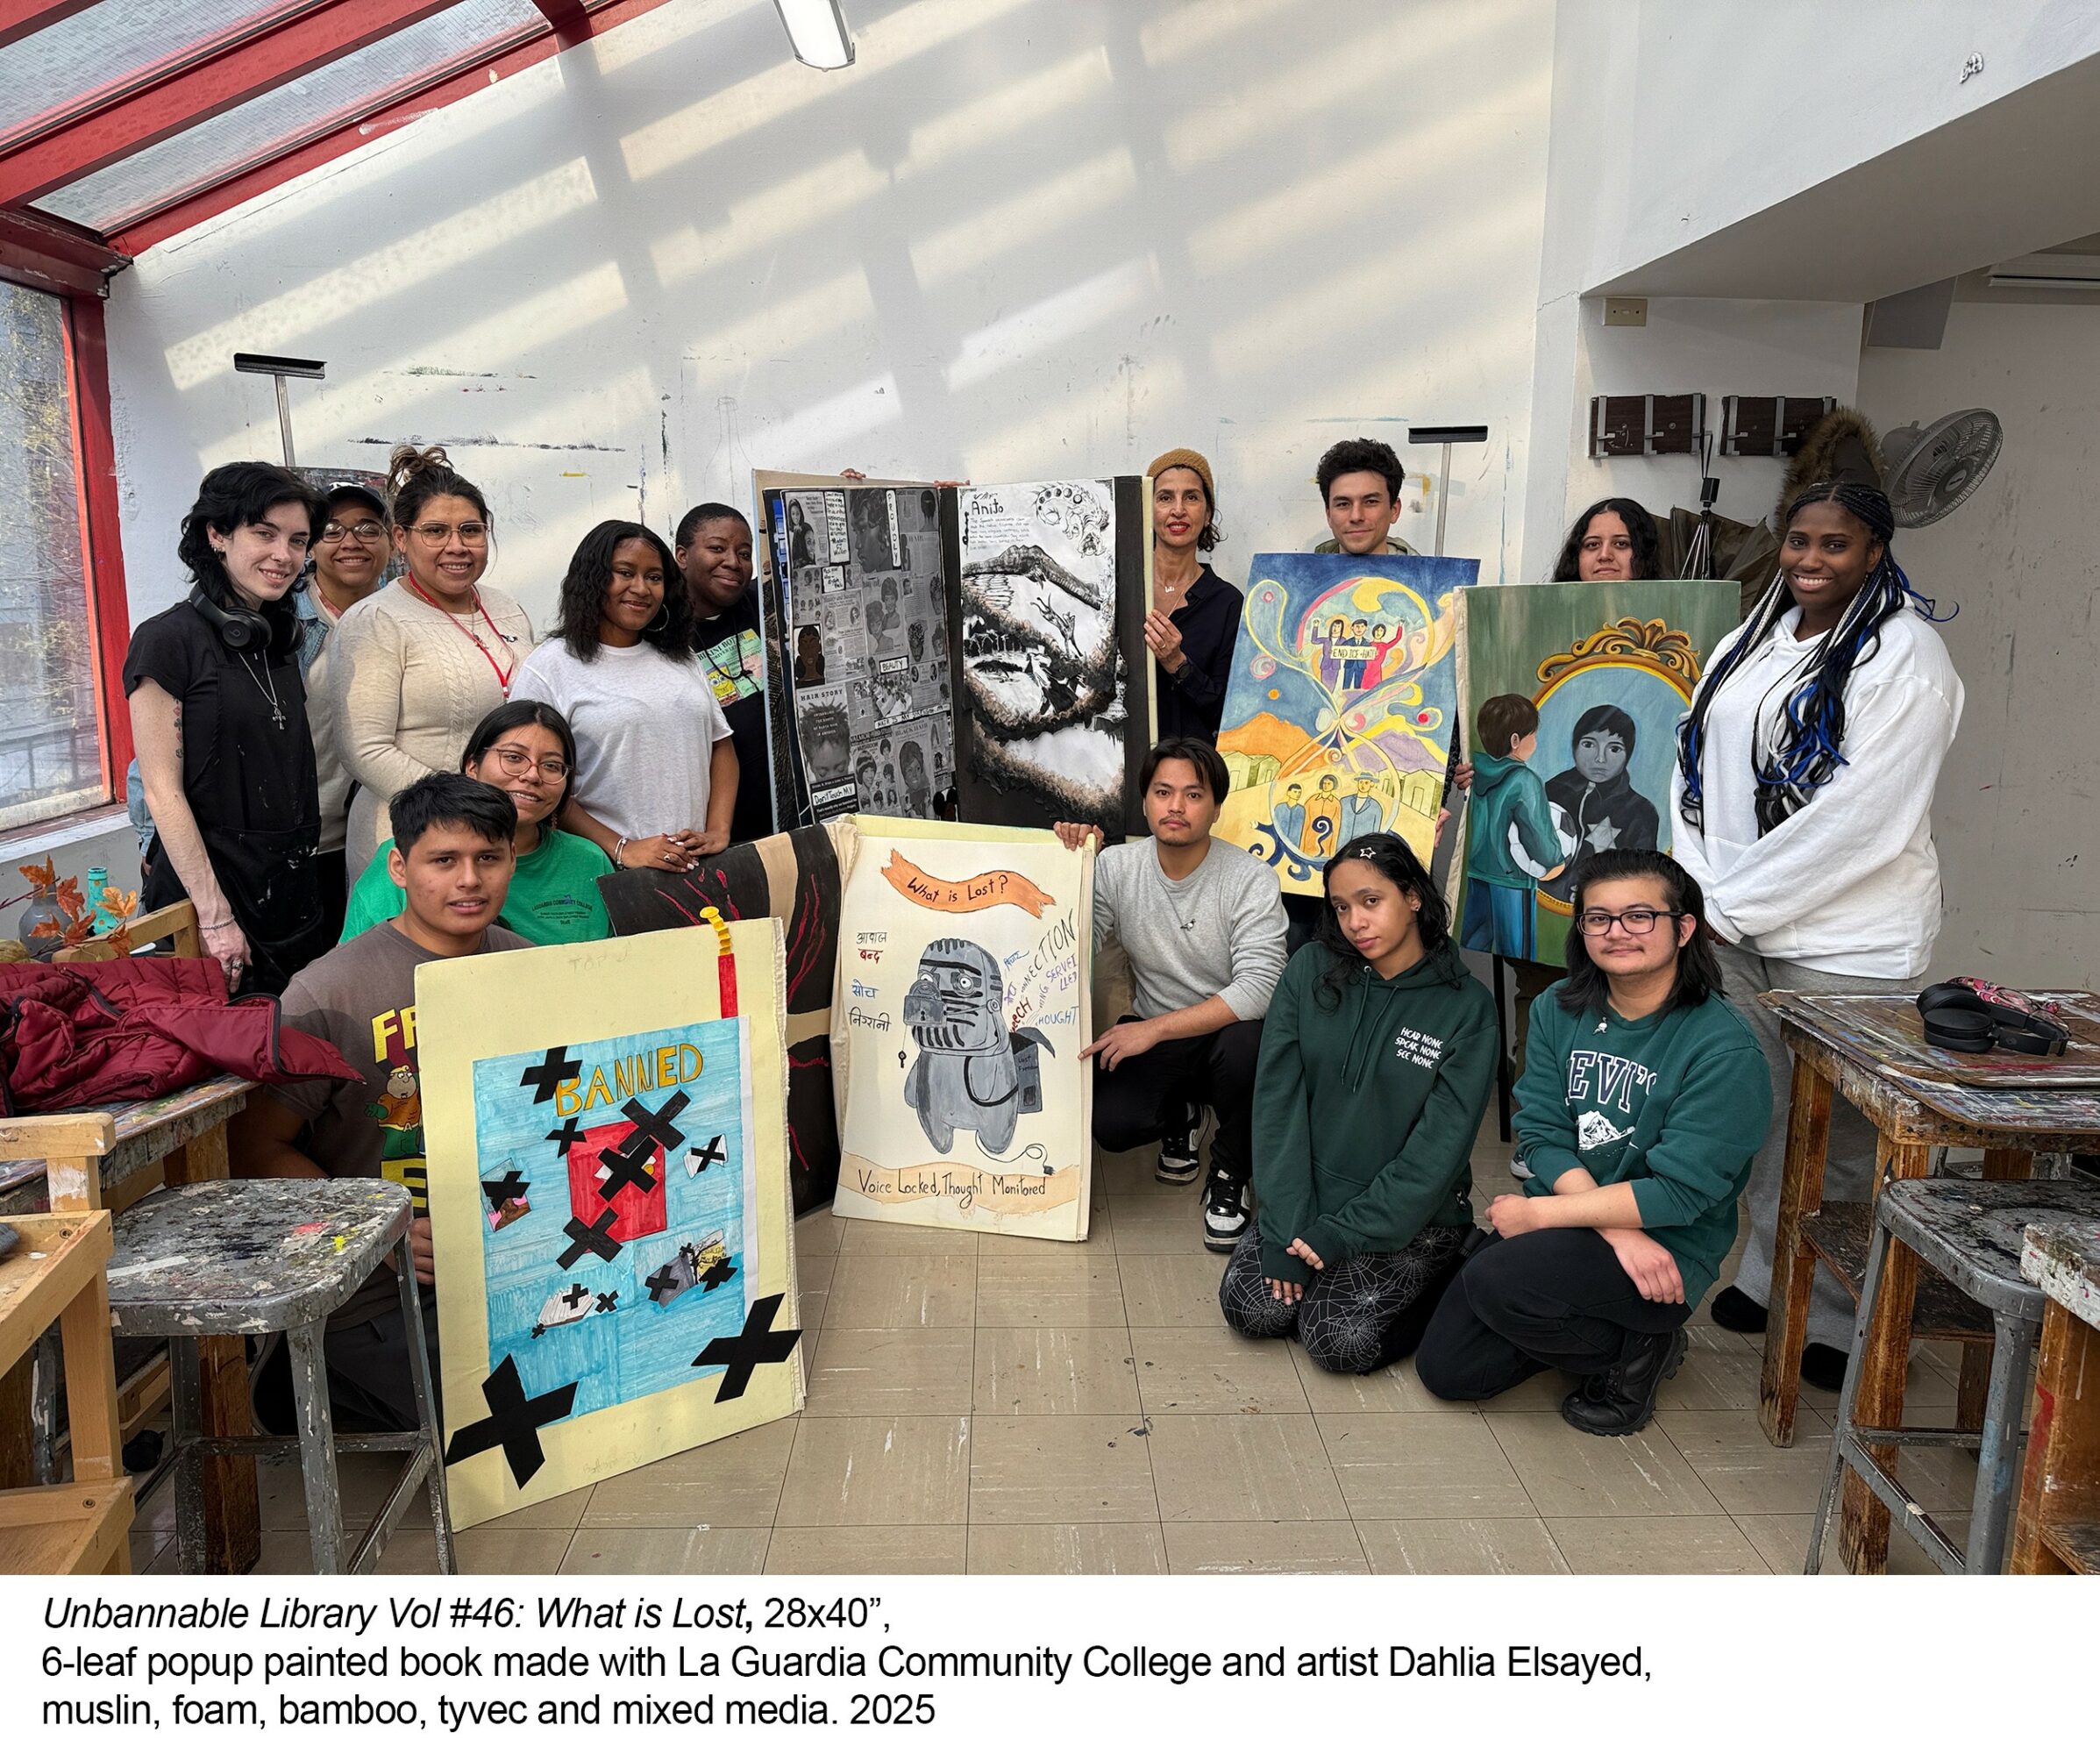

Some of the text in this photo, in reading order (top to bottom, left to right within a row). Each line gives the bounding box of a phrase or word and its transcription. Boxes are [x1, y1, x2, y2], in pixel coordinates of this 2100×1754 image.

[972, 499, 1004, 516] Anito
[886, 493, 900, 564] PROUDLY
[1333, 648, 1349, 659] END
[882, 660, 904, 672] BEAUTY
[801, 688, 844, 702] HAIR STORY
[908, 877, 940, 903] What
[949, 889, 958, 902] is
[1394, 1037, 1442, 1060] SPEAK NONE
[1400, 1027, 1444, 1049] HEAR NONE
[1396, 1049, 1434, 1069] SEE NONE
[556, 1042, 705, 1118] BANNED
[1565, 1050, 1657, 1114] EVI'
[858, 1168, 1046, 1209] Voice Locked, Thought Monitored
